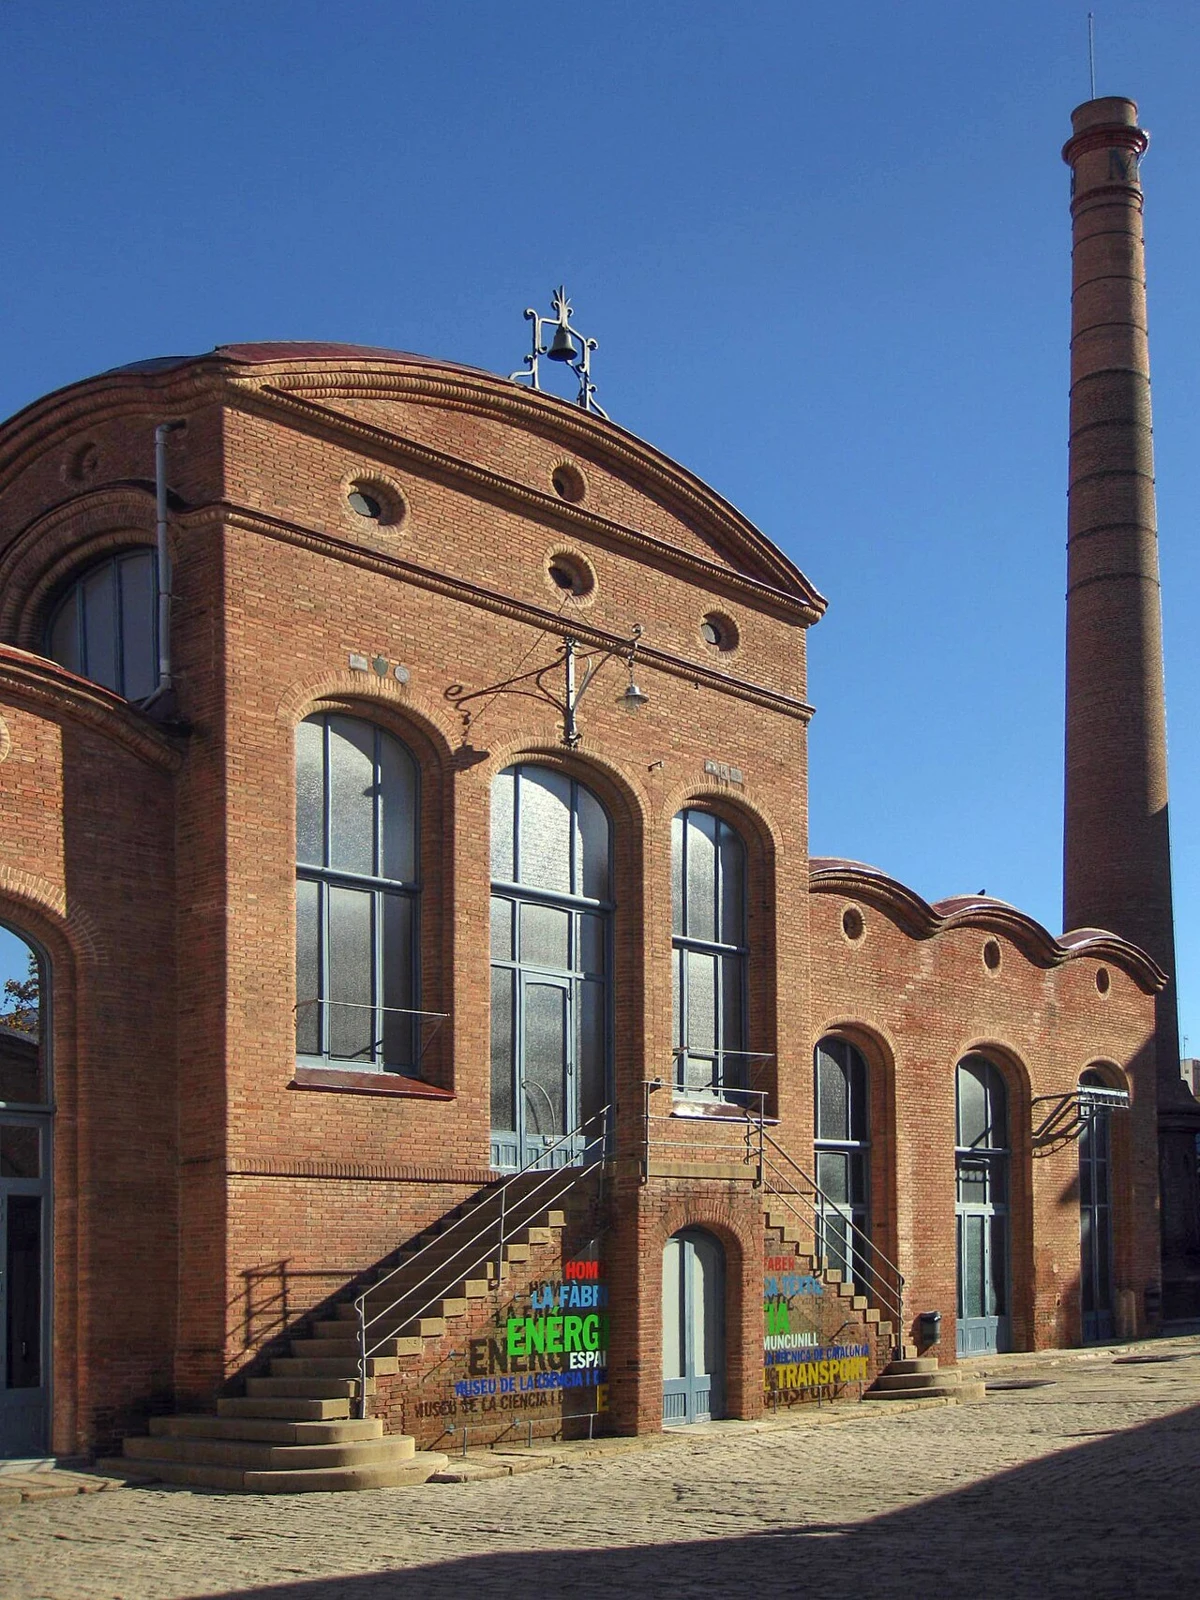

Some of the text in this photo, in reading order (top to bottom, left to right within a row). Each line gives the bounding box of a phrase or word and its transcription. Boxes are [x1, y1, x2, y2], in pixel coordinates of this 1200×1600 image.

[532, 1285, 552, 1308] LA
[764, 1333, 819, 1350] MUNCUNILL
[776, 1356, 869, 1390] TRANSPORT
[454, 1378, 497, 1397] MUSEU
[500, 1377, 516, 1393] DE
[519, 1375, 534, 1391] LA
